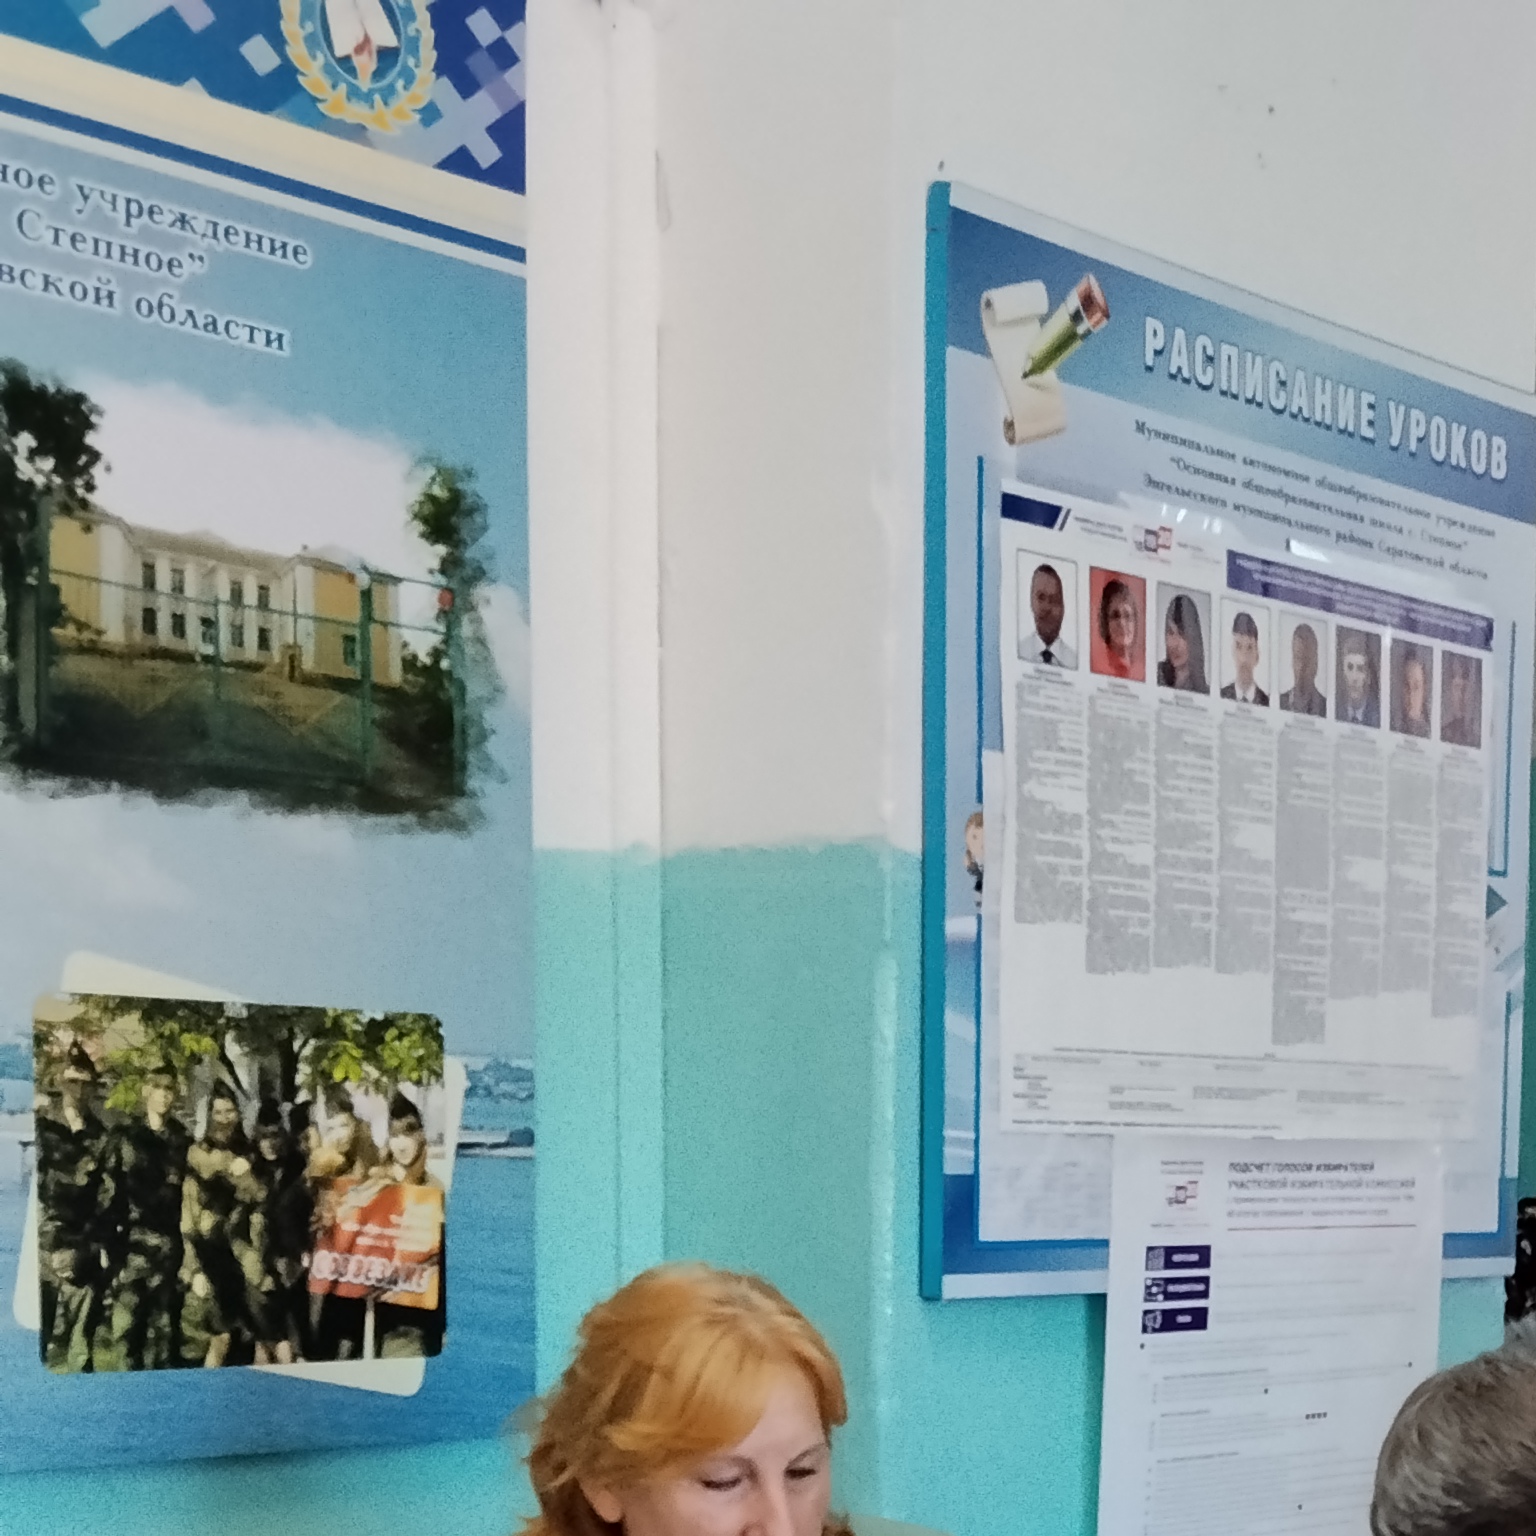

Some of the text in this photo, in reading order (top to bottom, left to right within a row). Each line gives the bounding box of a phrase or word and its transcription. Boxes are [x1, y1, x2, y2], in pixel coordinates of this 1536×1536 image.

[75, 183, 309, 266] учреждение
[0, 263, 287, 352] вской области
[1144, 315, 1508, 482] РАСПИСАНИЕ УРОКОВ
